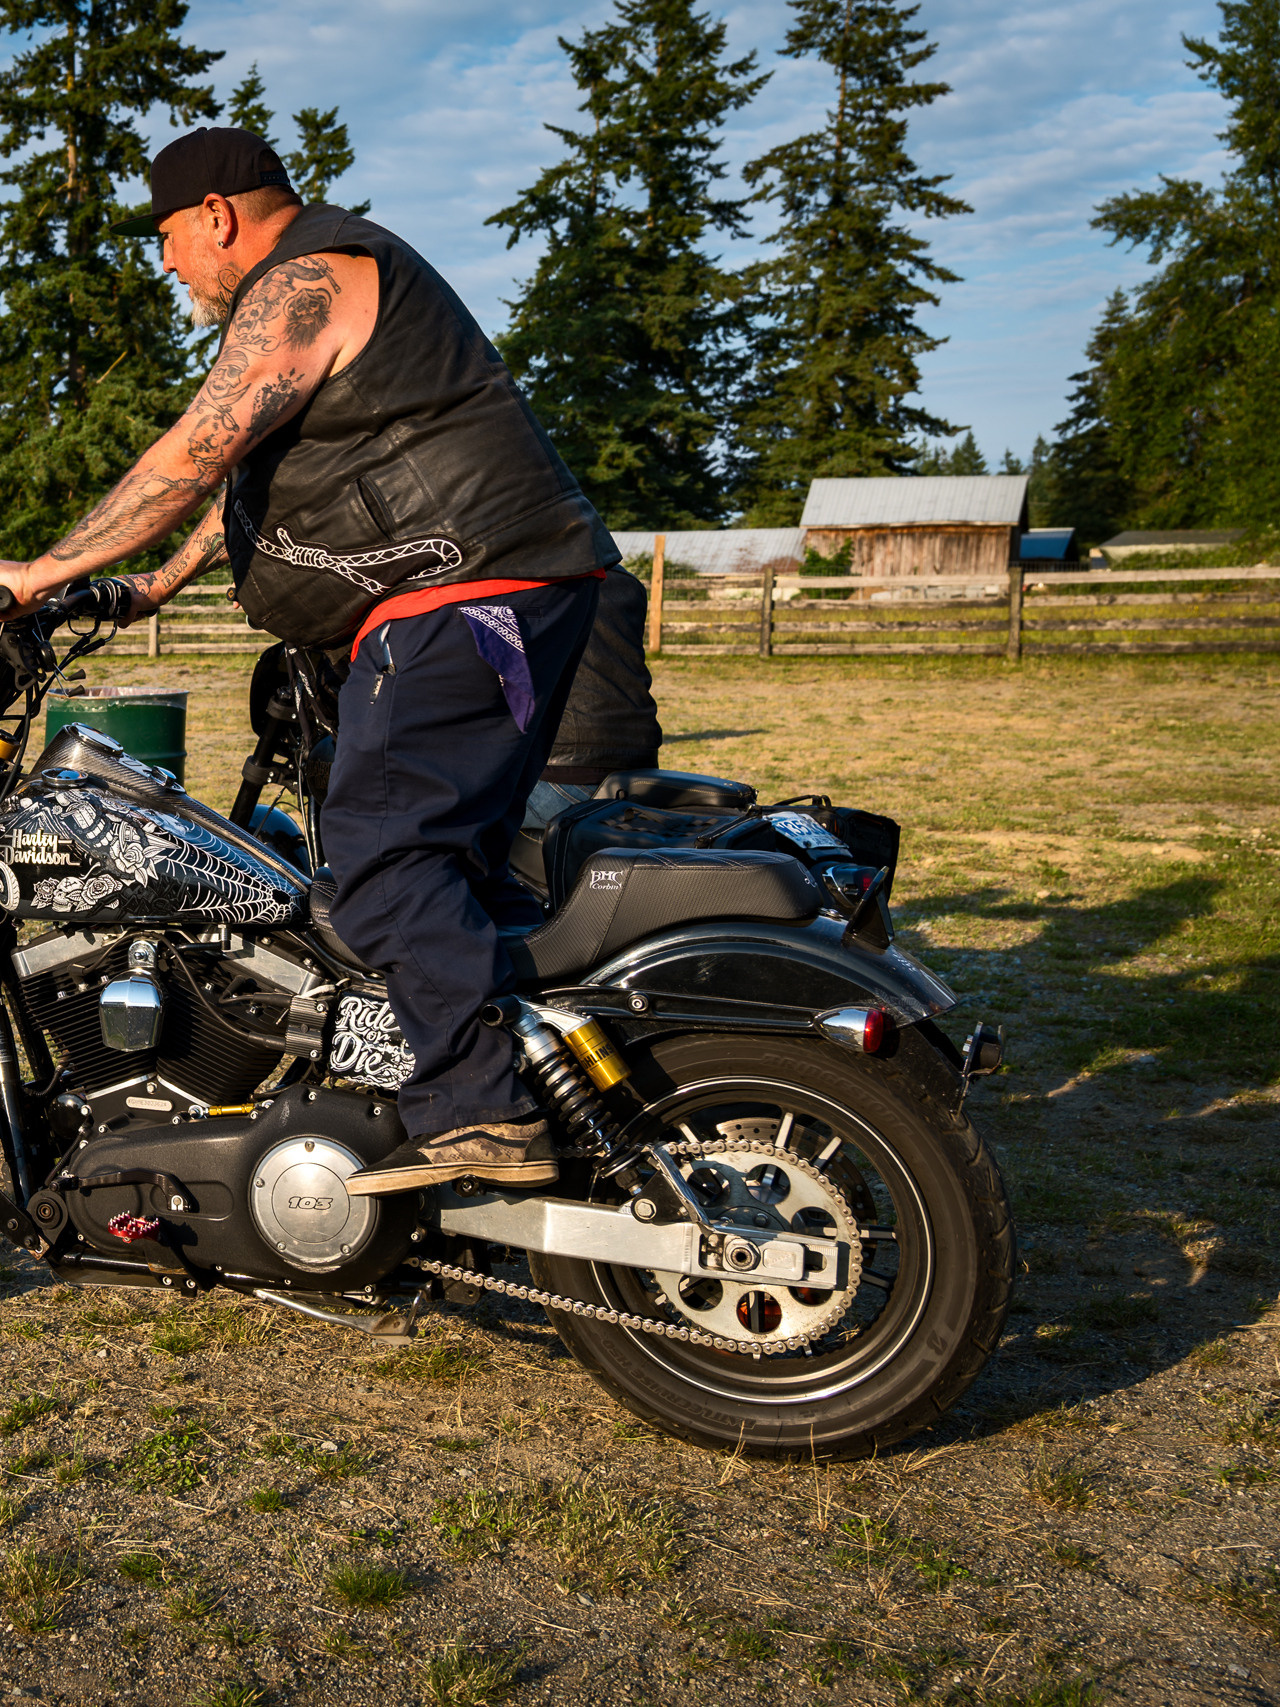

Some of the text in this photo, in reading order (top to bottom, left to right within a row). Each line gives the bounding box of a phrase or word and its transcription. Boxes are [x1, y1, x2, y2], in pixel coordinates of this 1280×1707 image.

[590, 869, 624, 885] BMC
[592, 882, 620, 890] Corbin
[335, 996, 401, 1034] Ride
[330, 1031, 393, 1075] Die
[288, 1196, 333, 1210] 103
